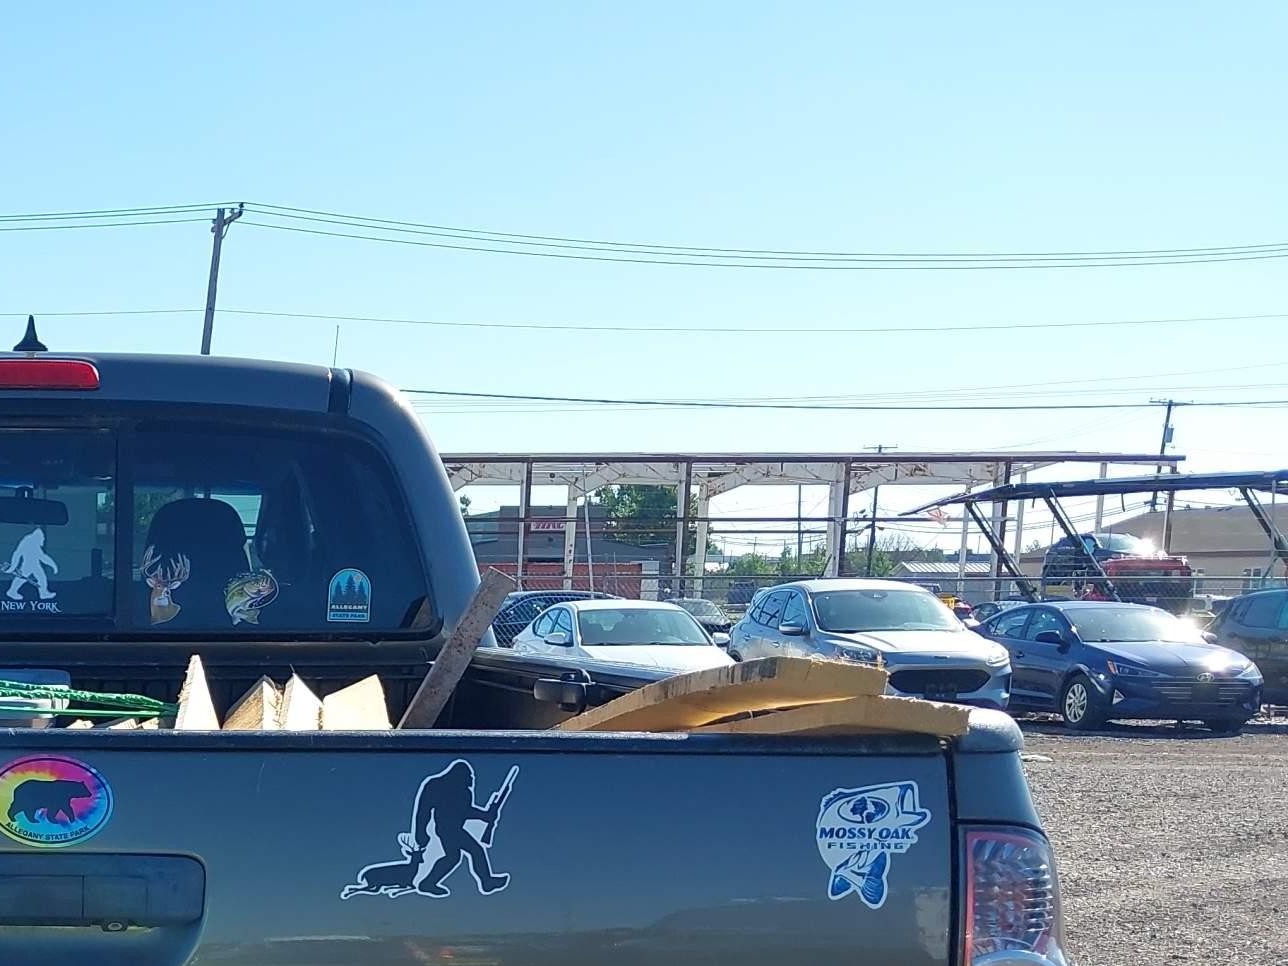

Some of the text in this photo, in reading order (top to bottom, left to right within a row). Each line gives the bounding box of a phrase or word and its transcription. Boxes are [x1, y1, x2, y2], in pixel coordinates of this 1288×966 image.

[6, 822, 90, 841] ALLEGANY STATE PARK
[819, 827, 877, 839] MOSSY
[827, 841, 905, 850] FISHING
